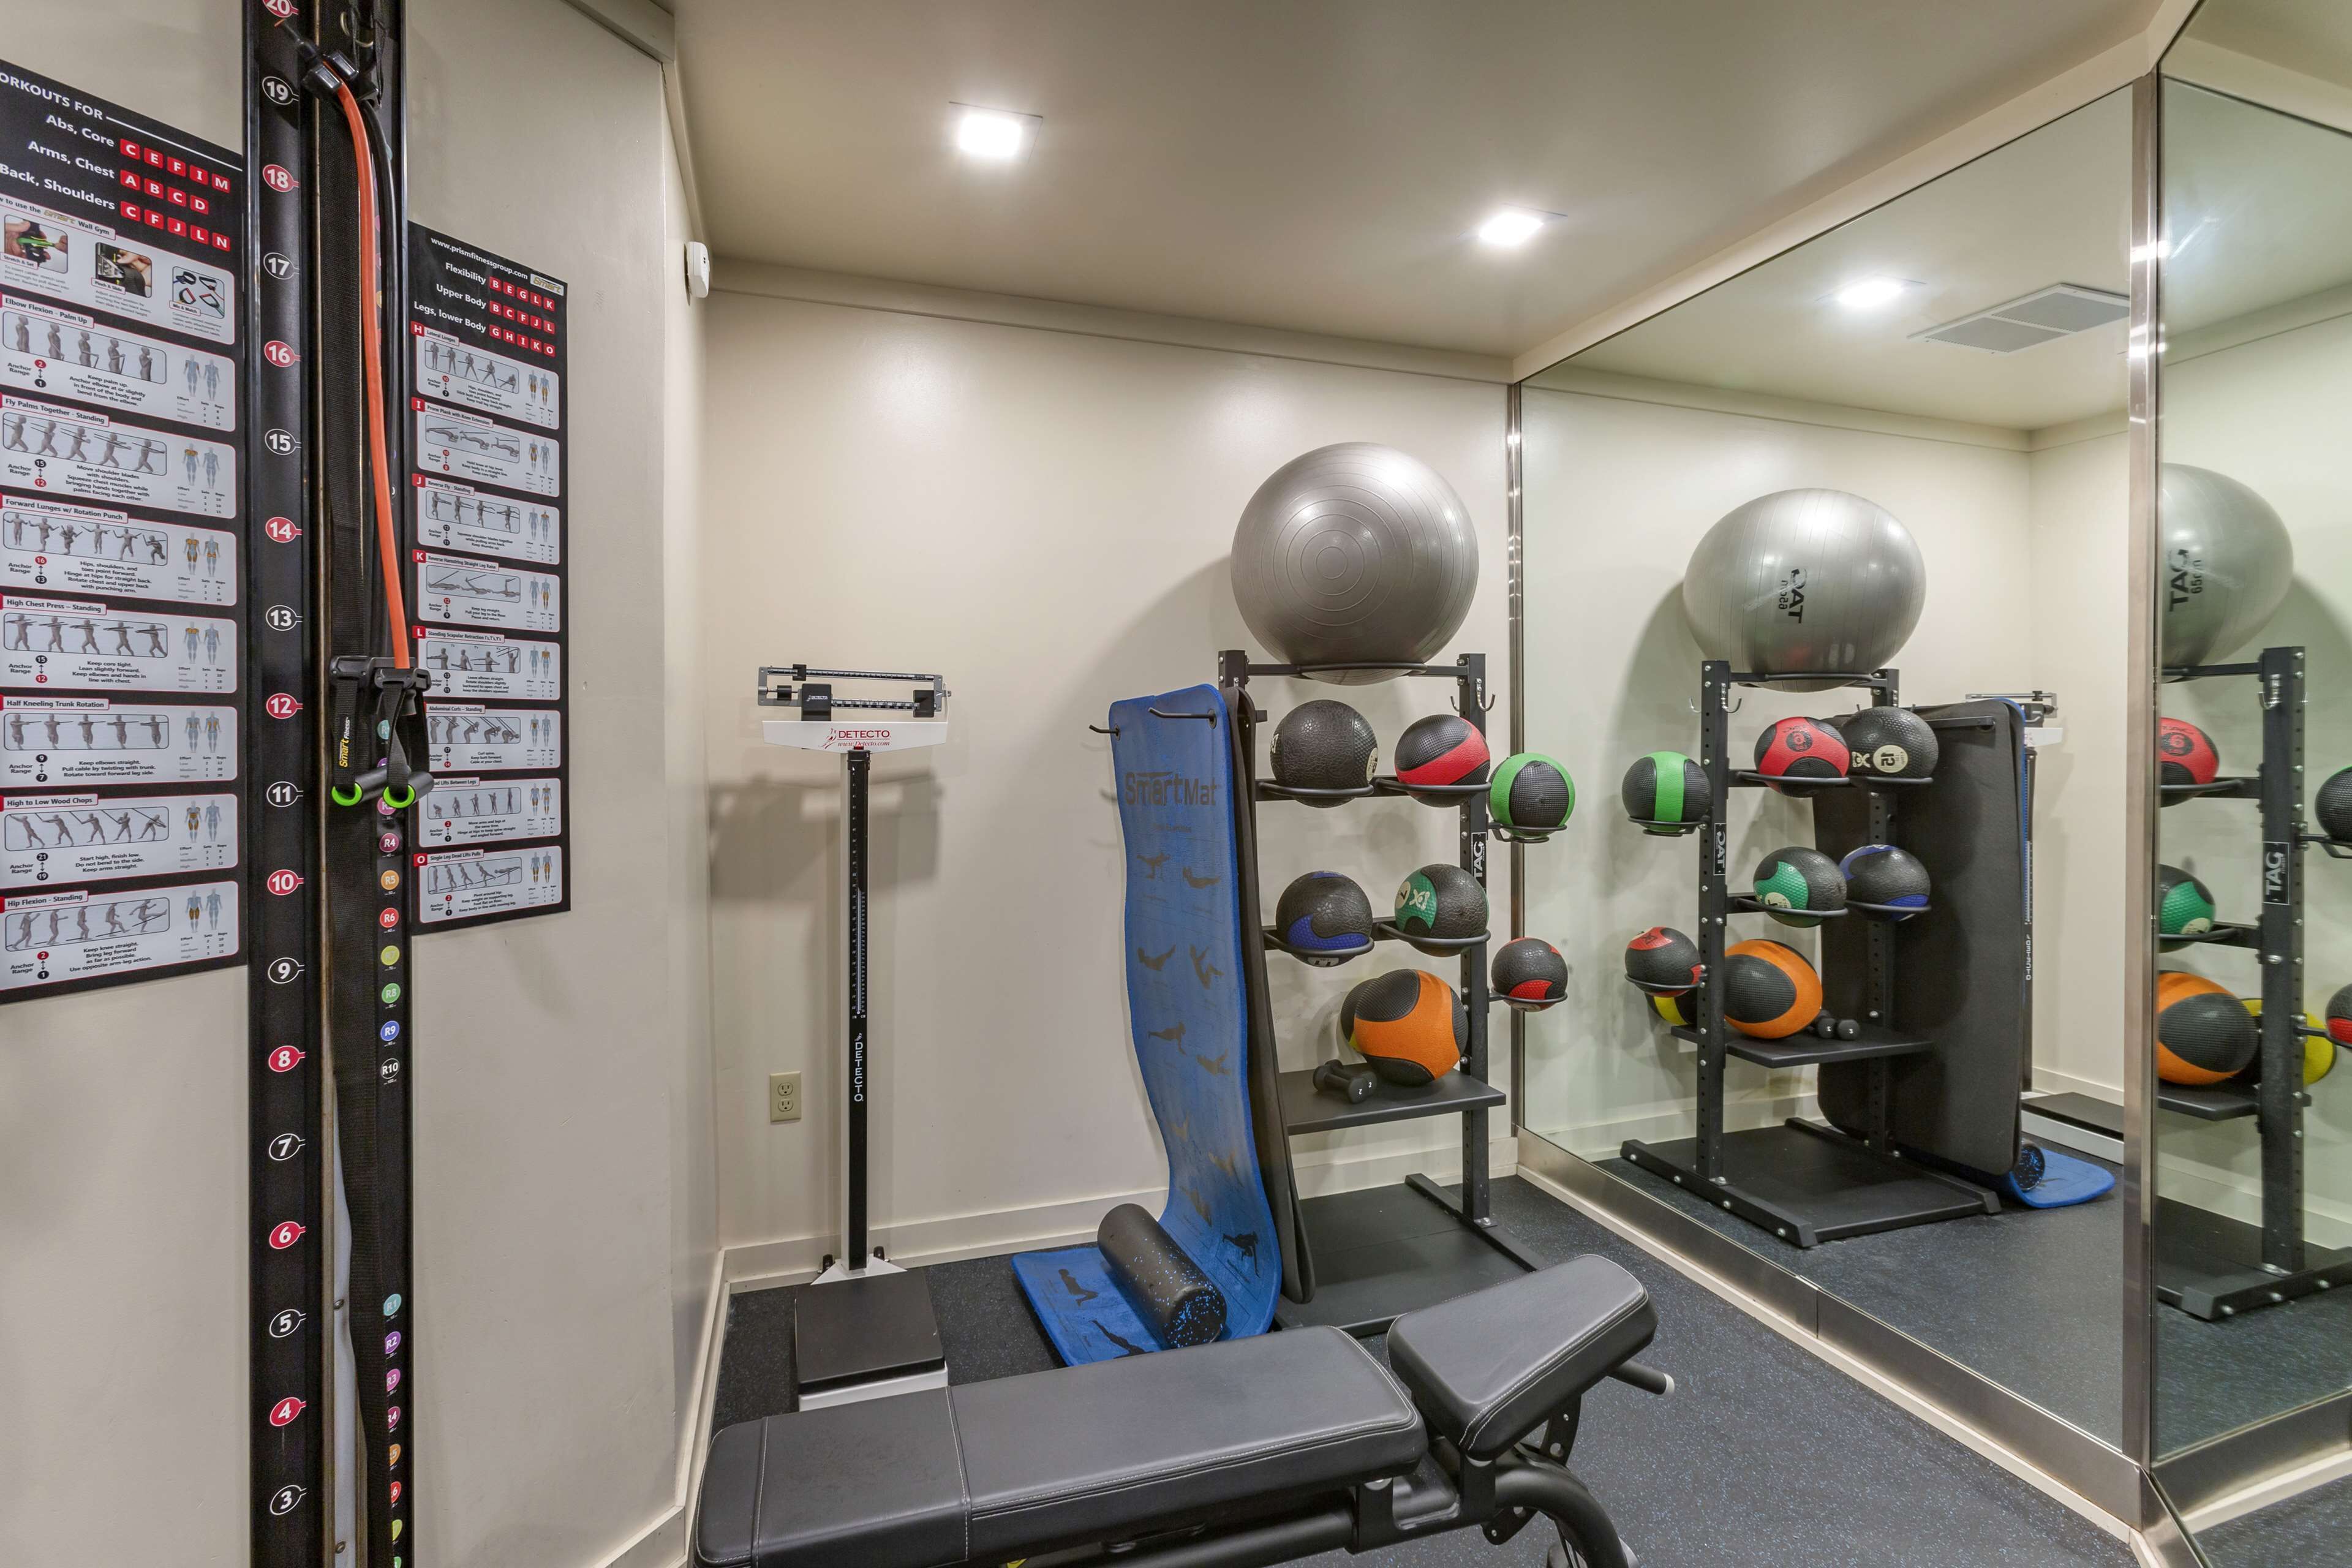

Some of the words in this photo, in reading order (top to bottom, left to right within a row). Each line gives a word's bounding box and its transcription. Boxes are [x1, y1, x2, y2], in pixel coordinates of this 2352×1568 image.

[266, 0, 290, 14] 20
[267, 81, 288, 102] 19
[75, 101, 103, 119] FOR
[47, 115, 77, 134] Abs,
[82, 127, 115, 147] Core
[126, 146, 135, 155] C
[151, 154, 158, 164] E
[174, 162, 181, 172] F
[197, 172, 202, 180] I
[216, 178, 228, 190] M
[28, 141, 70, 164] Arms,
[75, 157, 115, 178] Chest
[125, 177, 137, 186] A
[151, 184, 159, 194] B
[173, 193, 182, 203] C
[195, 200, 205, 209] D
[267, 168, 288, 189] 18
[0, 164, 39, 186] Back,
[44, 179, 115, 209] Shoulders
[127, 208, 135, 217] C
[151, 214, 158, 224] F
[175, 222, 181, 232] J
[197, 231, 203, 239] L
[217, 238, 227, 247] N
[78, 221, 92, 230] Wall
[94, 227, 110, 235] Gym
[268, 257, 290, 276] 17
[431, 237, 528, 280] www.prismfitnessgroup.com
[445, 262, 486, 285] Flexibility
[436, 284, 463, 300] Upper
[465, 291, 486, 309] Body
[6, 298, 26, 311] Elbow
[29, 303, 53, 316] Flexion
[60, 312, 77, 322] Palm
[413, 301, 437, 317] Legs,
[439, 309, 463, 323] lower
[465, 315, 486, 333] Body
[269, 345, 290, 364] 16
[6, 398, 15, 407] Fly
[18, 401, 39, 411] Palms
[41, 404, 69, 417] Together
[77, 412, 105, 424] Standing
[472, 416, 489, 425] Extension
[269, 434, 291, 451] 15
[6, 499, 35, 509] Forward
[37, 503, 60, 514] Lunges
[74, 508, 100, 516] Rotation
[104, 511, 123, 520] Punch
[270, 522, 292, 538] 14
[7, 599, 24, 608] High
[26, 600, 45, 609] Chest
[47, 601, 64, 610] Press
[72, 604, 101, 613] Standing
[271, 610, 292, 626] 13
[23, 700, 53, 709] Kneeling
[271, 698, 292, 714] 12
[339, 738, 350, 767] Smart
[7, 799, 24, 808] High
[69, 797, 92, 806] Chops
[272, 786, 291, 802] 11
[384, 838, 396, 847] R4
[1474, 841, 1485, 879] TAG
[385, 876, 396, 885] R5
[2266, 851, 2284, 895] TAG
[272, 874, 294, 891] 10
[21, 897, 47, 907] Flexion
[53, 894, 83, 903] Standing
[384, 913, 395, 922] R6
[385, 951, 395, 960] R7
[278, 962, 290, 979] 9
[386, 988, 396, 998] R8
[385, 1025, 396, 1036] R9
[278, 1051, 290, 1068] 8
[382, 1062, 398, 1076] R10
[854, 1042, 864, 1102] DETECTO
[279, 1137, 292, 1157] 7
[280, 1227, 291, 1243] 6
[386, 1299, 397, 1311] R1
[280, 1315, 291, 1333] 5
[386, 1336, 397, 1349] R2
[386, 1374, 396, 1386] R3
[279, 1402, 291, 1419] 4
[281, 1491, 292, 1510] 3
